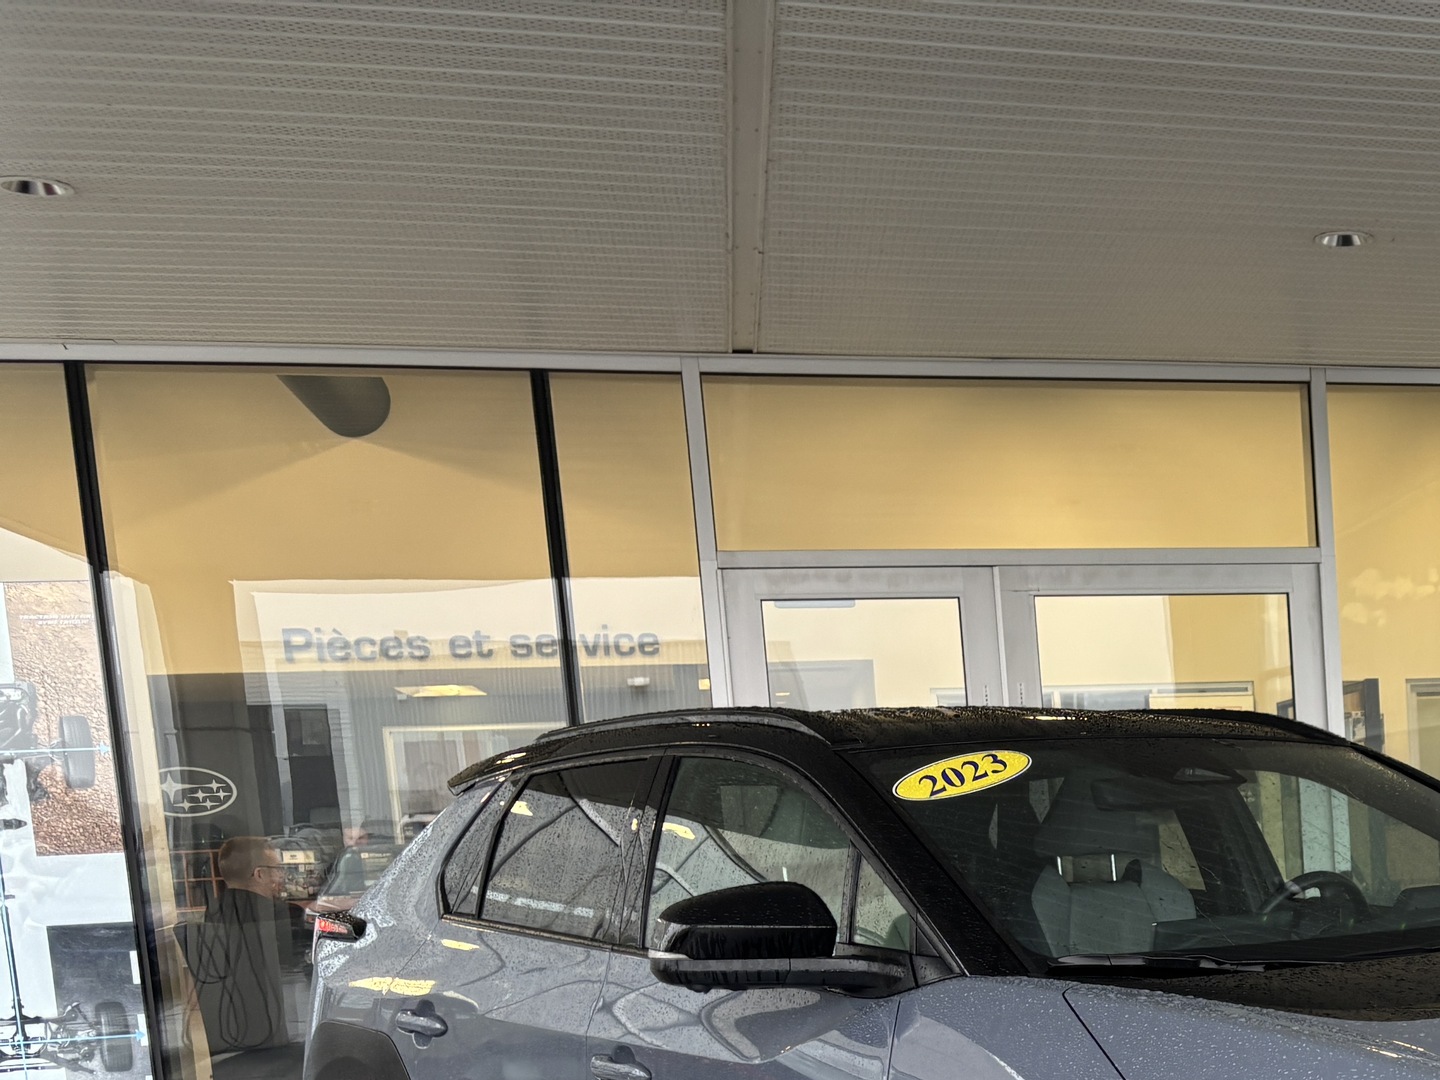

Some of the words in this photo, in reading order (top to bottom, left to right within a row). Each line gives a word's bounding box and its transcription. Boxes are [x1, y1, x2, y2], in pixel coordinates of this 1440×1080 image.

[281, 626, 432, 664] Pièces
[448, 629, 494, 660] et
[510, 624, 660, 658] sevice
[919, 753, 1008, 798] 2023
